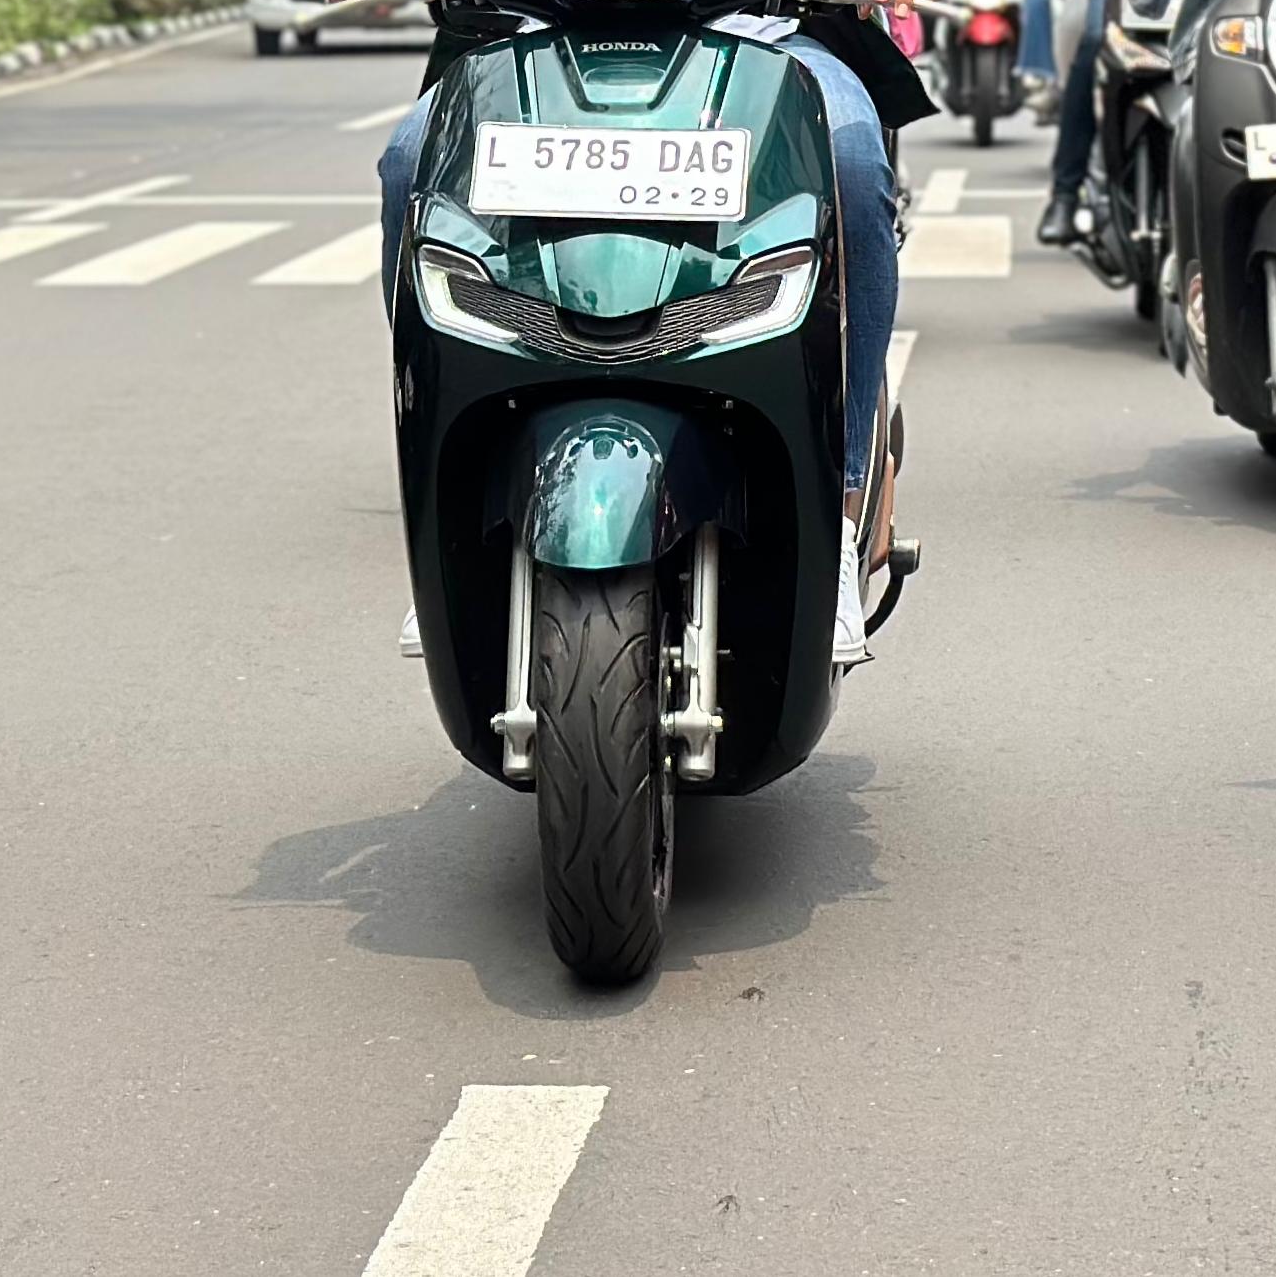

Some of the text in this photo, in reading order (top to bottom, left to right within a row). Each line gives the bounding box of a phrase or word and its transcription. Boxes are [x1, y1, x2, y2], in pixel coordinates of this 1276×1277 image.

[580, 41, 663, 53] HONDA
[1253, 131, 1267, 151] L
[488, 136, 733, 173] L 5785 DAG
